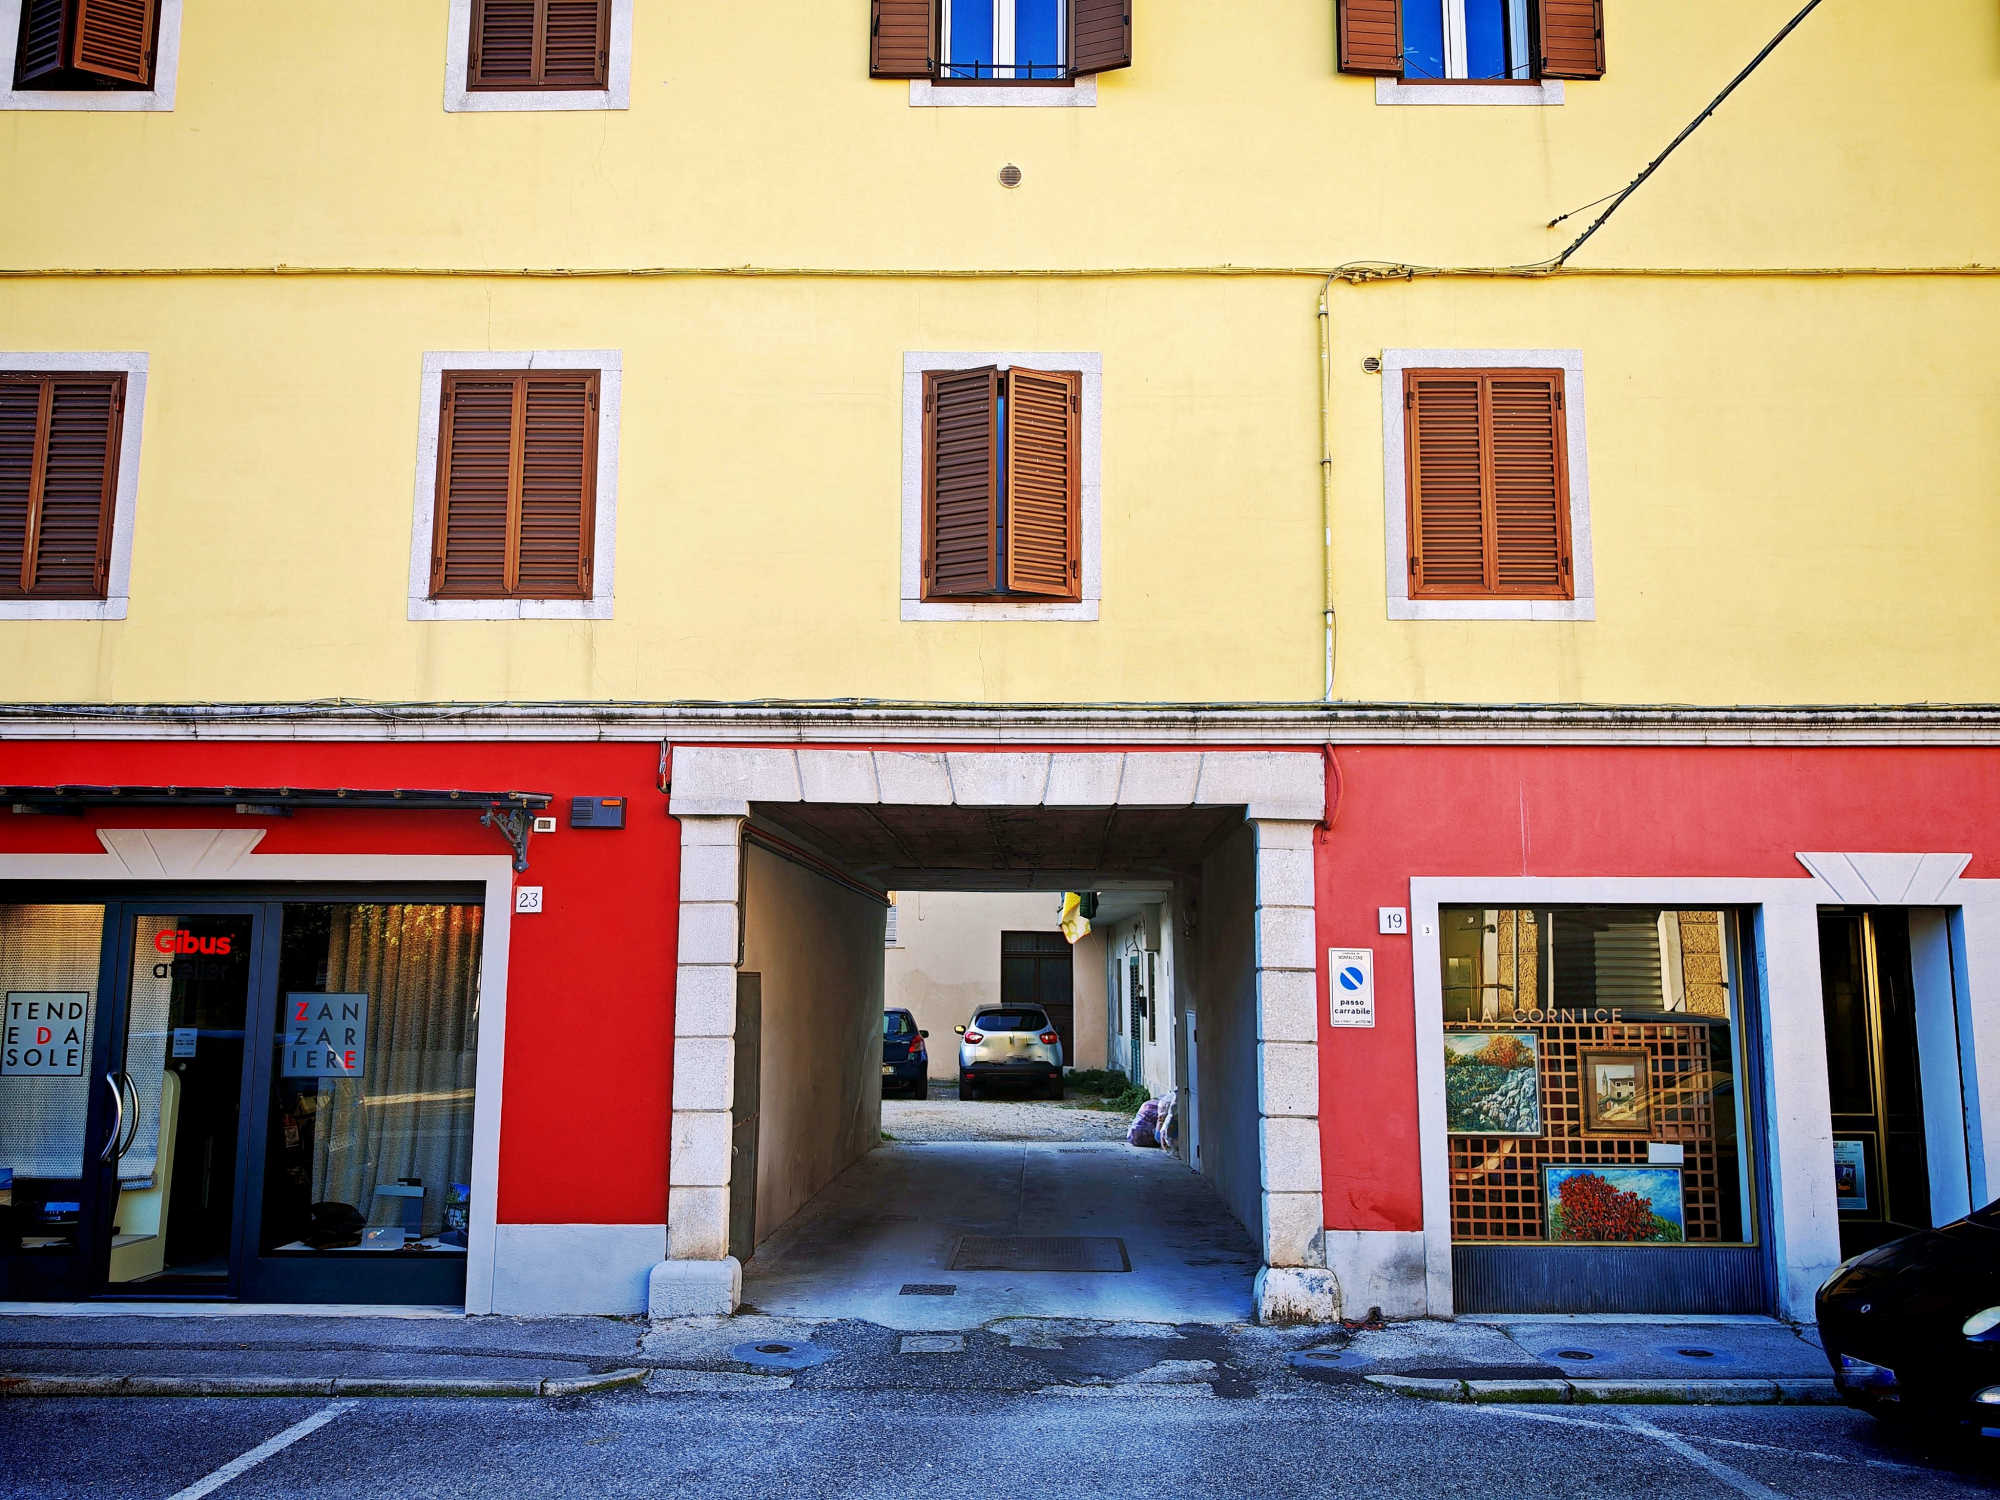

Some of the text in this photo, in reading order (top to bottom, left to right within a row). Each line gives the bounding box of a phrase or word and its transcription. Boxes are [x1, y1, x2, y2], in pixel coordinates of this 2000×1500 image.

[519, 893, 538, 907] 23
[1387, 913, 1402, 928] 19
[154, 929, 231, 955] Gibus
[11, 1002, 83, 1020] TEND
[295, 1001, 359, 1021] ZAN
[1334, 1007, 1371, 1015] carrabile
[1466, 1008, 1623, 1023] LA CORNICE
[294, 1027, 356, 1046] ZAR
[6, 1048, 79, 1067] SOLE
[292, 1050, 357, 1069] IERE
